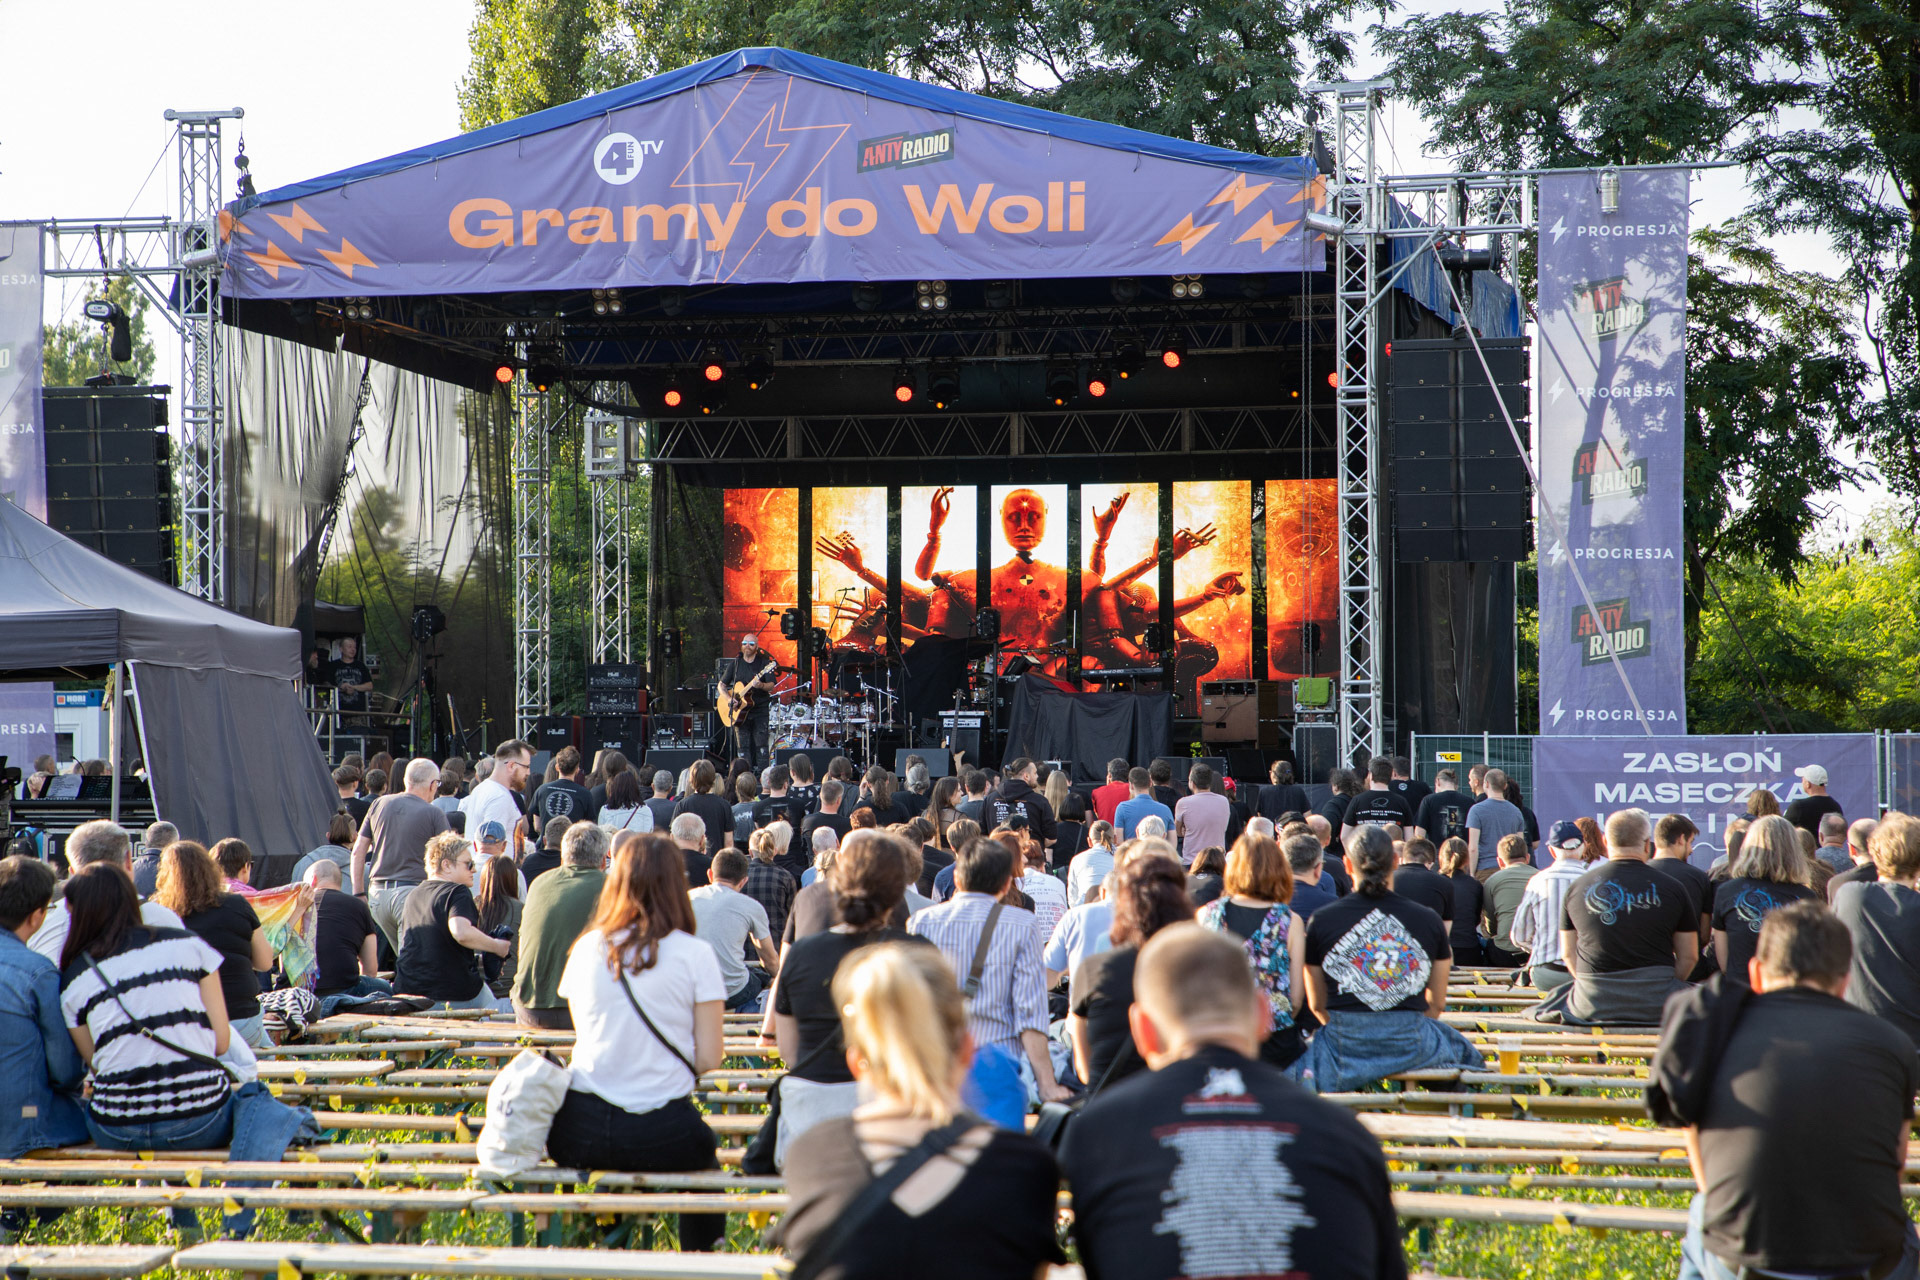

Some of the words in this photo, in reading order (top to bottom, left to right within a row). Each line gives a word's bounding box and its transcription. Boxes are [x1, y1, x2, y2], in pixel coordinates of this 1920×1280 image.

[627, 141, 635, 159] FUN
[640, 139, 664, 155] TV
[448, 197, 747, 252] Gramy
[766, 186, 878, 238] do
[901, 180, 1086, 235] Woli
[1577, 223, 1679, 237] PROGRESJA
[1591, 303, 1644, 334] RADIO
[1575, 385, 1676, 398] PROGRESJA
[1590, 465, 1642, 495] RADIO
[1574, 547, 1675, 560] PROGRESJA
[1589, 627, 1645, 657] RADIO
[1623, 747, 1782, 773] ZASŁOŃ
[1372, 949, 1399, 971] 27
